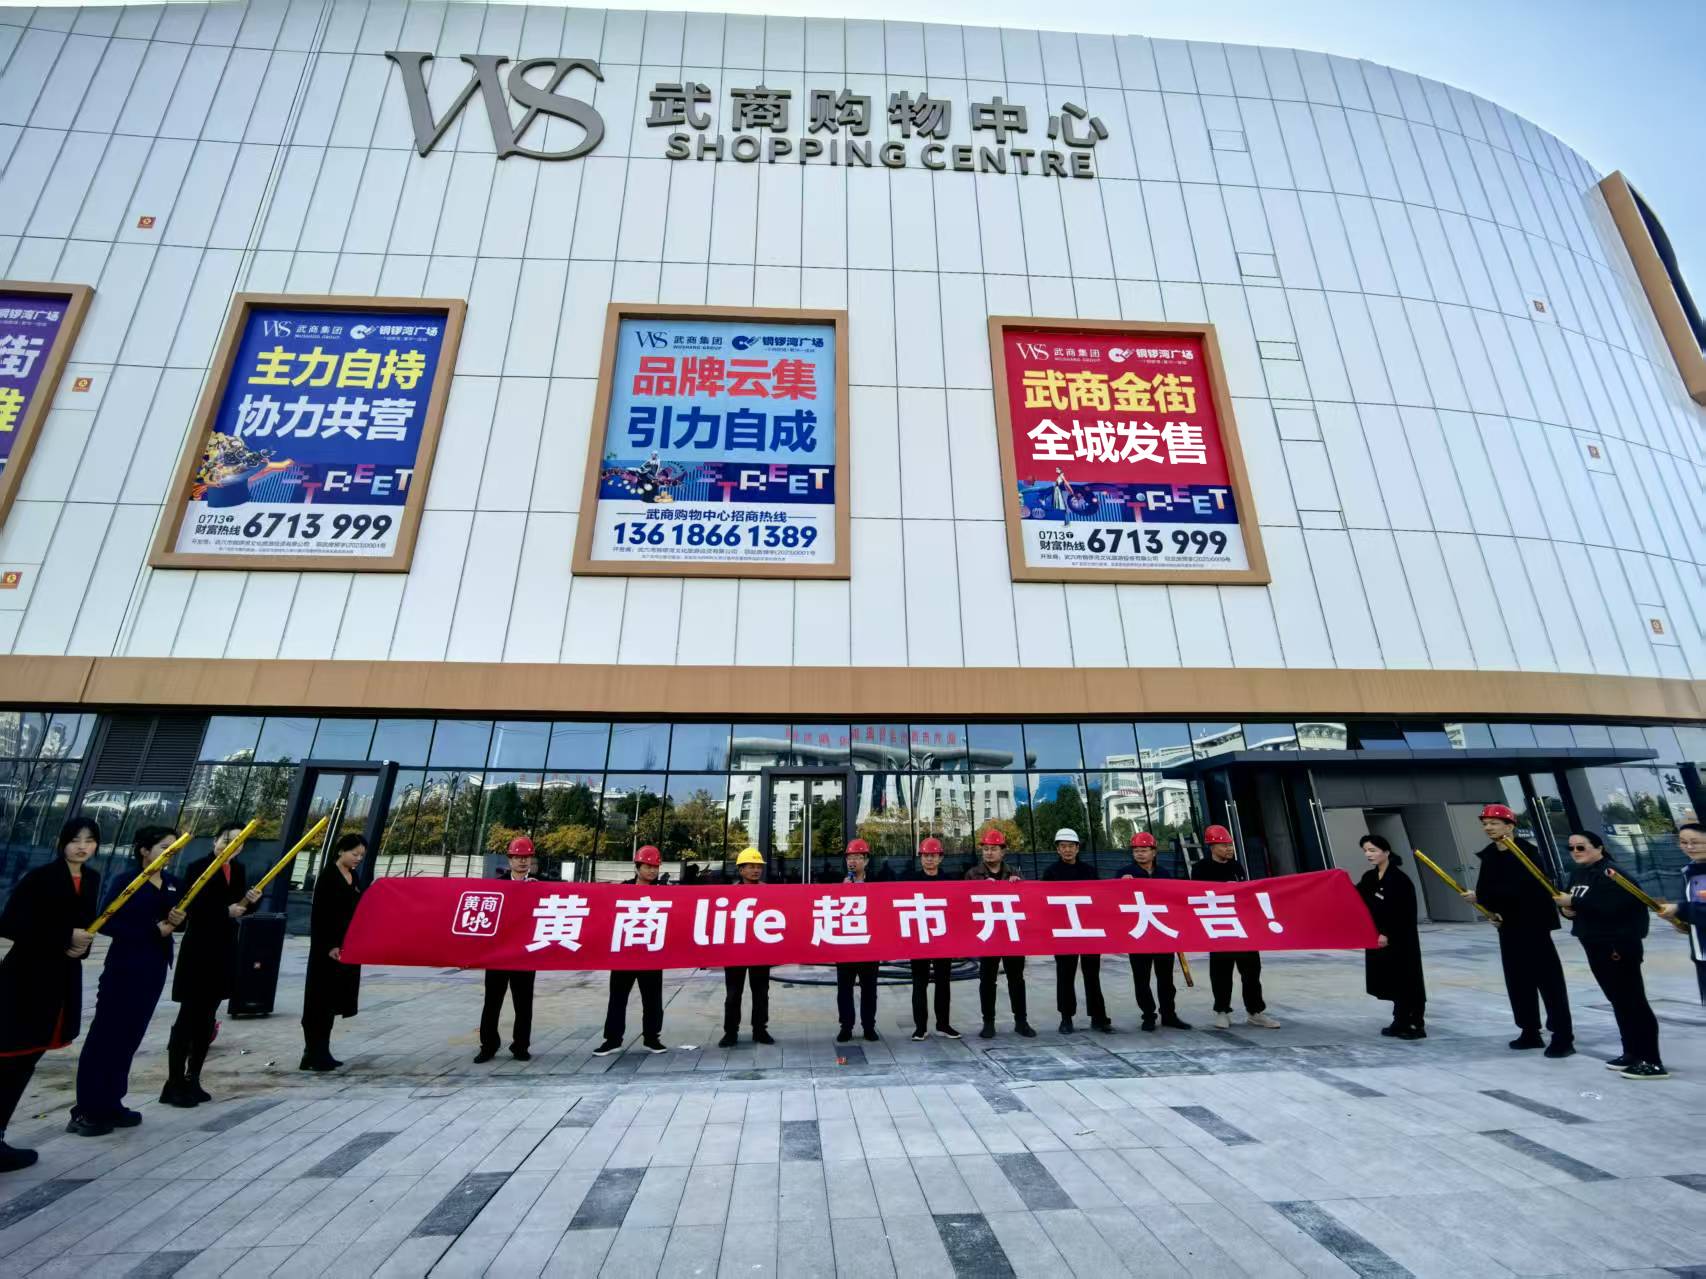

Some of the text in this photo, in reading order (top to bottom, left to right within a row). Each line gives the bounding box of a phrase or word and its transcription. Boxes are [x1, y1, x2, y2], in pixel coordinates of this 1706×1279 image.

[385, 51, 605, 161] WS
[646, 82, 1109, 148] 武商购物中心
[665, 132, 1094, 178] SHOPPING CENTRE
[263, 320, 293, 337] WS
[296, 325, 343, 335] 武商集团
[635, 331, 668, 349] WS
[673, 335, 723, 345] 武商集团
[762, 335, 824, 348] 铜锣湾广场
[1016, 342, 1049, 361] WS
[1053, 347, 1100, 358] 武商集团
[248, 345, 426, 390] 主力自持
[632, 356, 817, 400] 品牌云集
[1022, 369, 1197, 414] 武商金街
[234, 394, 416, 441] 协力共营
[628, 405, 817, 452] 引力自成
[1026, 419, 1207, 465] 全城发售
[198, 514, 226, 524] 0713
[243, 512, 393, 541] 6713 999
[646, 508, 788, 523] 武商购物中心招商热线
[195, 524, 241, 536] 财富热线
[613, 522, 818, 548] 136 1866 1389
[1039, 530, 1066, 540] 0713
[1039, 540, 1086, 551] 财富热线
[1087, 528, 1227, 555] 6713 999
[463, 895, 498, 911] 黄商
[525, 894, 673, 953] 黄商
[693, 897, 786, 946] life
